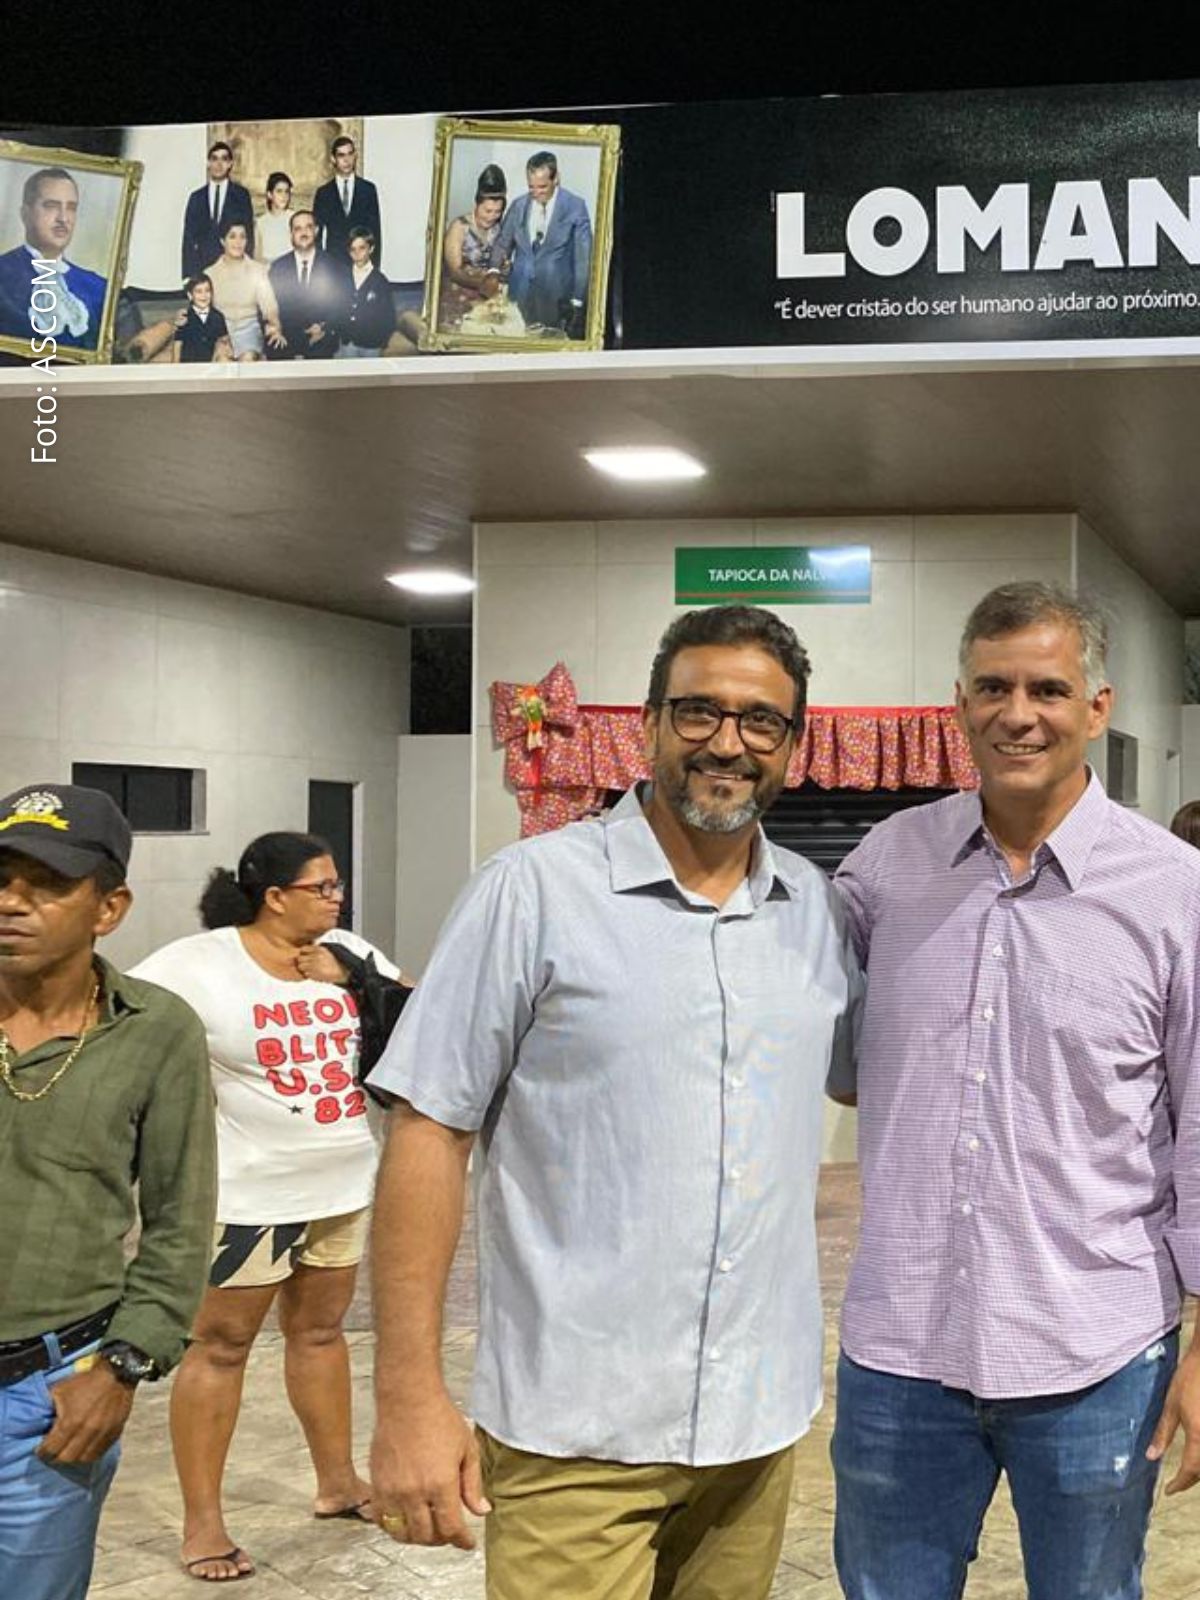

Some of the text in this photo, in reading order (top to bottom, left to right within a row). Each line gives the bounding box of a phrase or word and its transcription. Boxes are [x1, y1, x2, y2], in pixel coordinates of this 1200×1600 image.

[794, 299, 843, 318] dever
[846, 298, 901, 317] cristão
[905, 296, 928, 315] do
[932, 299, 957, 313] ser
[960, 295, 1034, 313] humano
[1038, 292, 1092, 315] ajudar
[1096, 294, 1118, 310] ao
[1123, 289, 1200, 313] próximo.
[708, 568, 767, 582] TAPIOCA
[769, 568, 790, 581] DA
[256, 1028, 362, 1067] BLIT
[314, 1090, 368, 1124] 82
